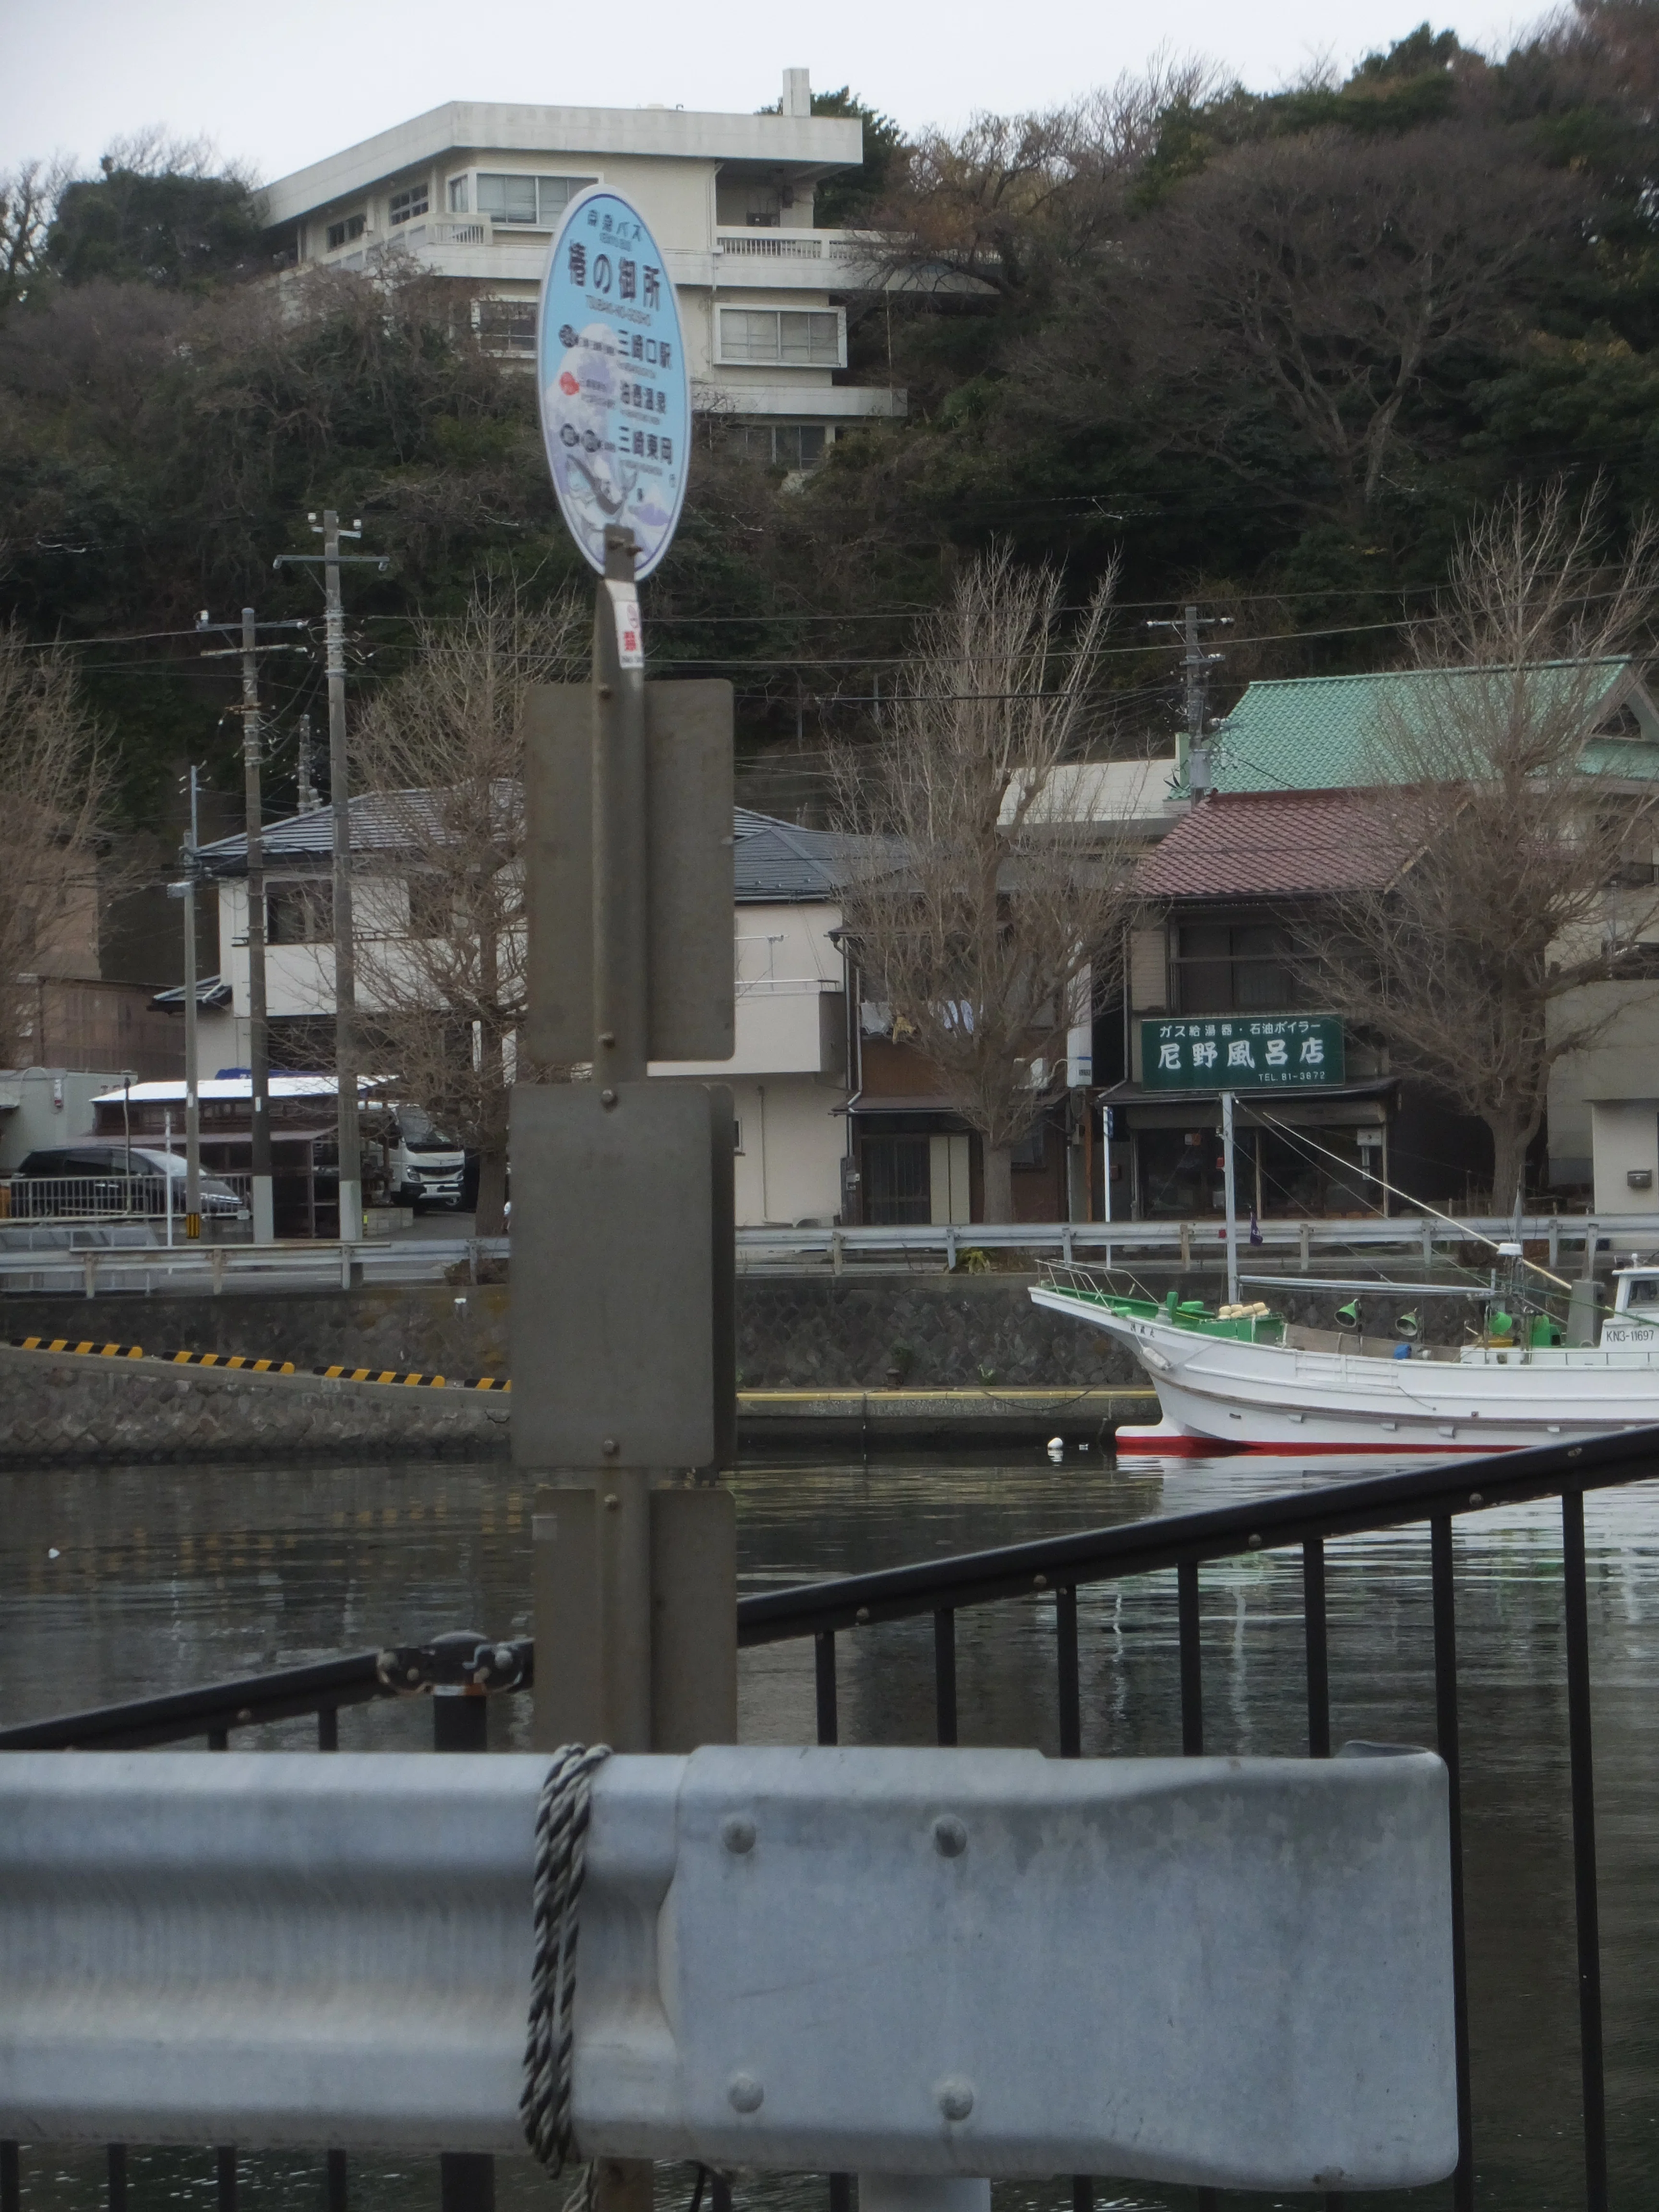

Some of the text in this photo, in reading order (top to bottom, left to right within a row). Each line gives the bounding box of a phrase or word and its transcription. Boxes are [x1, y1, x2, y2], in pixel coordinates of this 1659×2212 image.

[1158, 1036, 1325, 1069] 尼野風呂店
[1258, 1071, 1325, 1082] TEL. 81-3672
[1607, 1330, 1654, 1342] KN3-11697
